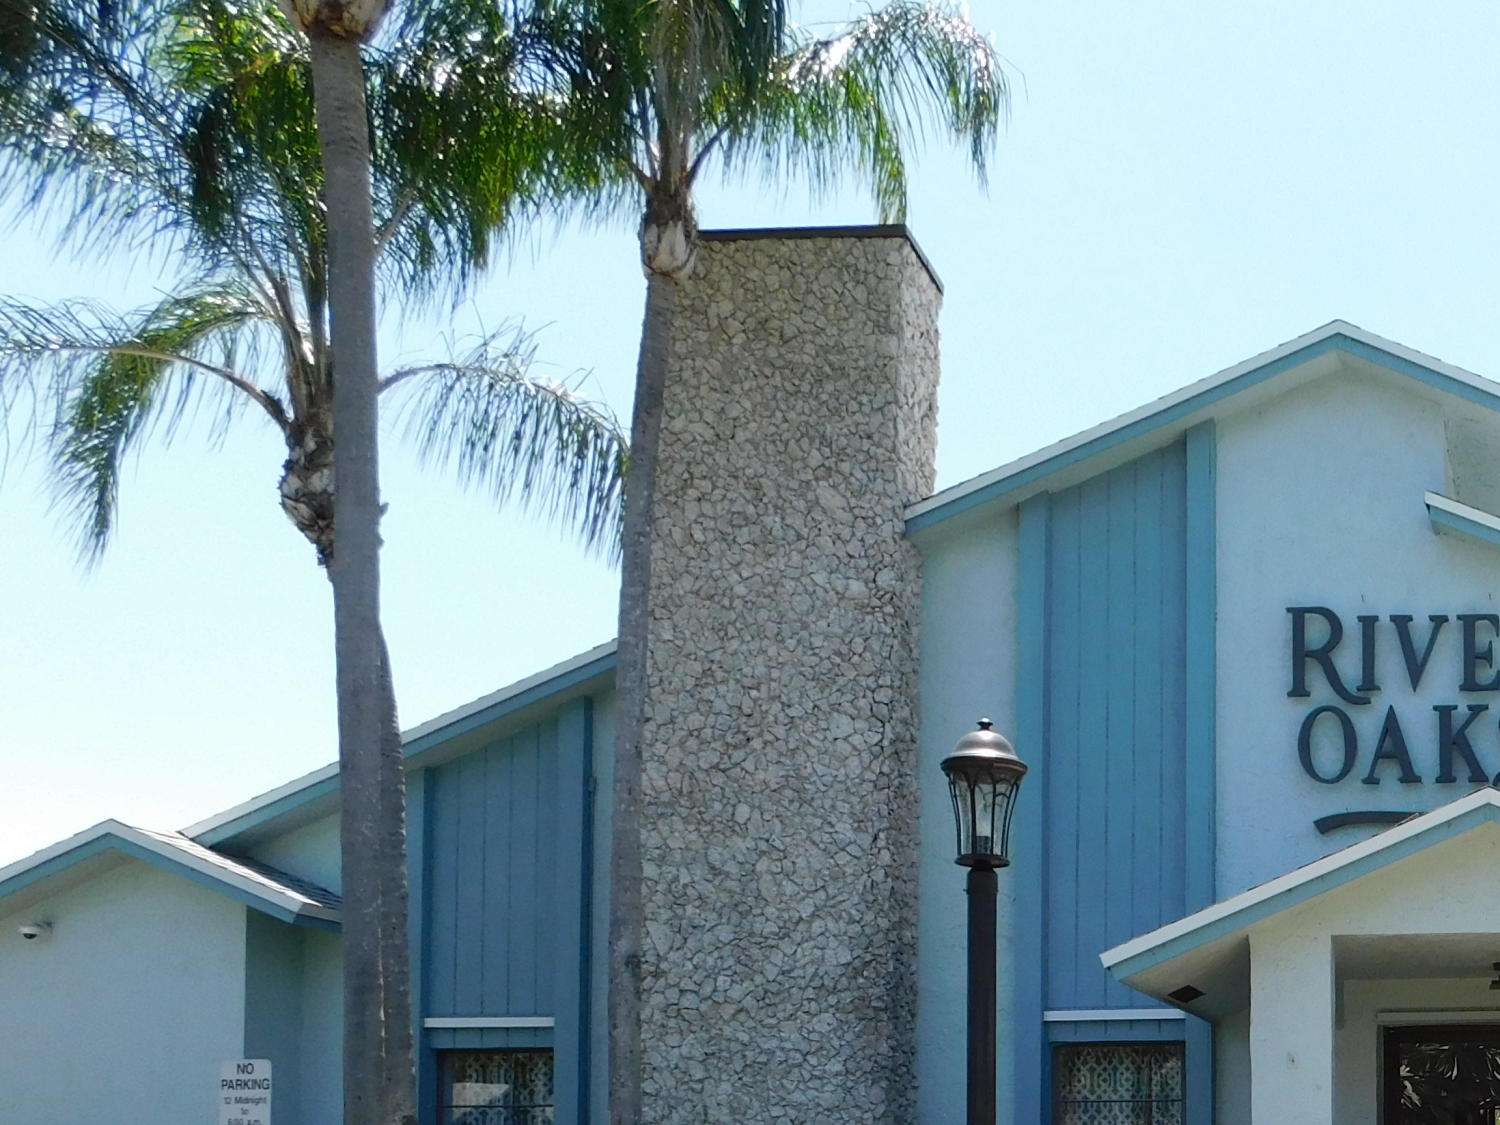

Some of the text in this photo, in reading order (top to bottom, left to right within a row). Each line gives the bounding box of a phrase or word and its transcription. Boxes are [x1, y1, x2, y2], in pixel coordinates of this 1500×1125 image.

[236, 1063, 255, 1075] NO
[221, 1078, 270, 1090] PARKING
[235, 1096, 267, 1106] Midnight
